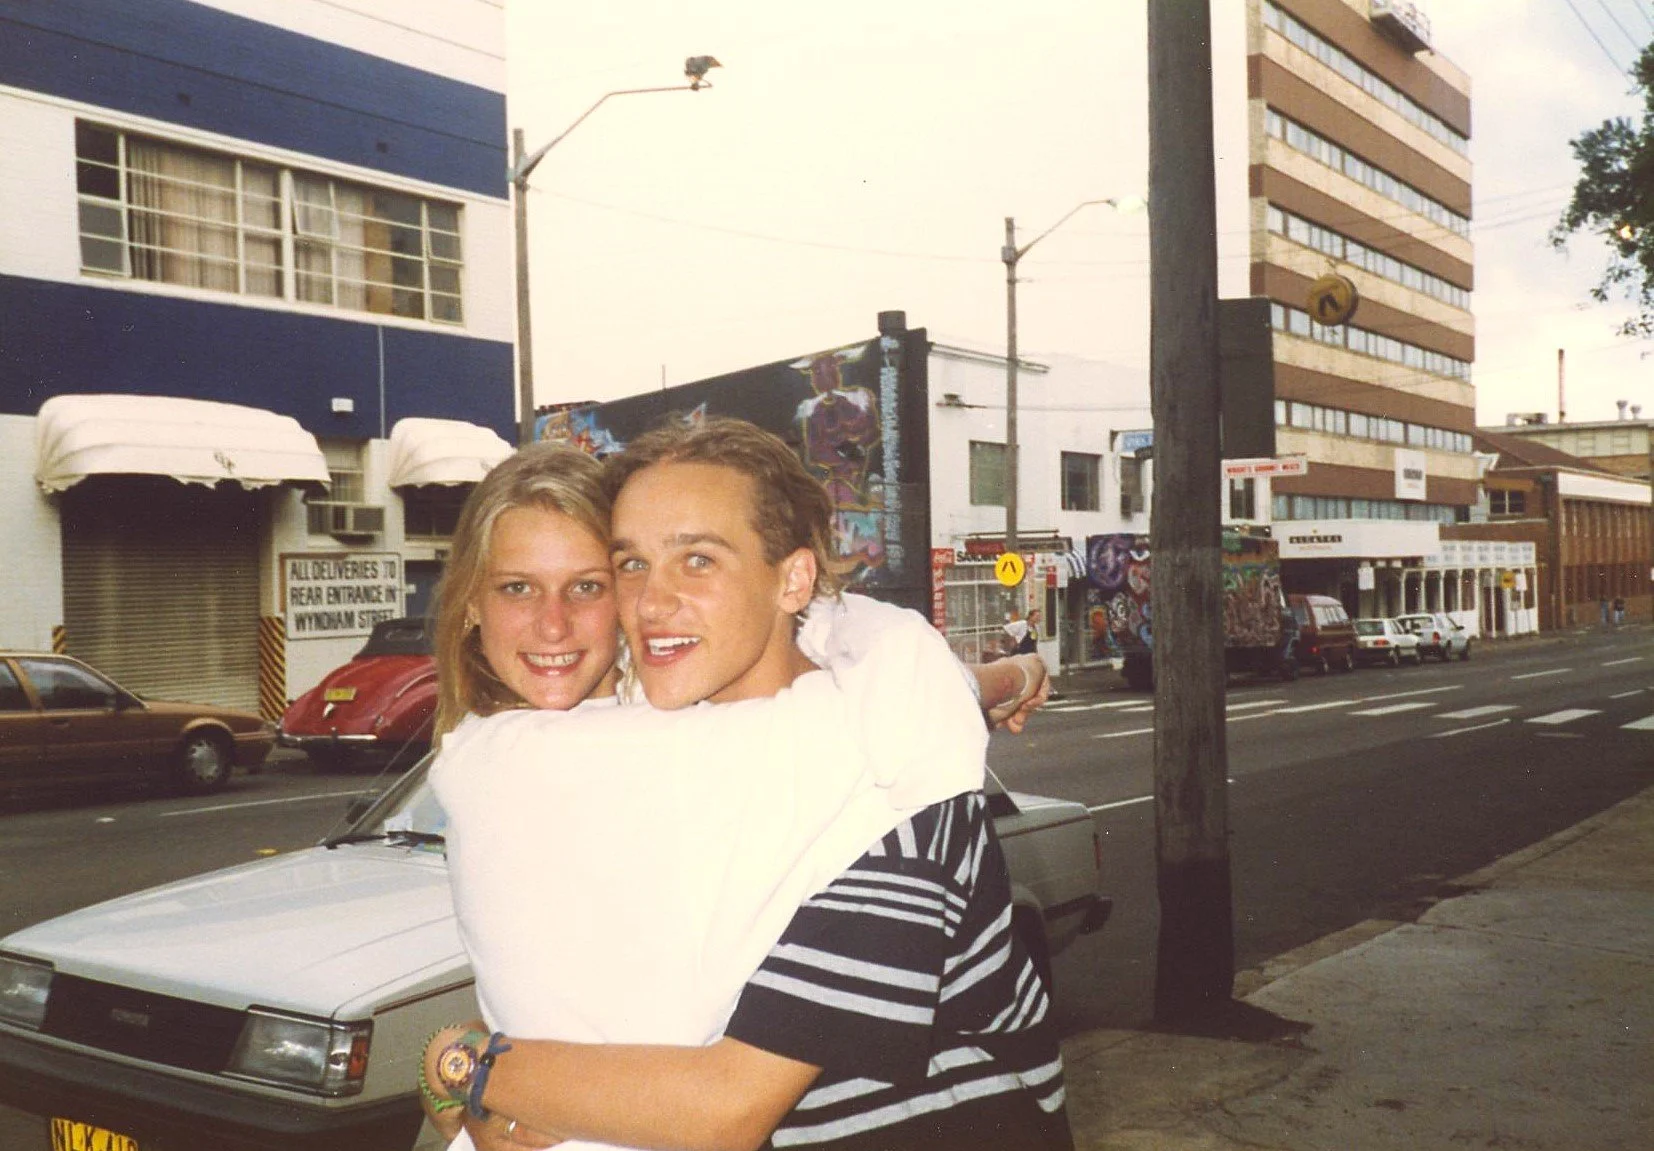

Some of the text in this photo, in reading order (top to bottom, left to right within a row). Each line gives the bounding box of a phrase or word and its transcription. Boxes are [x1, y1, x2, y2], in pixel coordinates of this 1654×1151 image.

[290, 560, 396, 580] ALL DELIVERIES TO
[290, 585, 396, 606] REAR ENTRANCE IN
[294, 611, 354, 631] WYNDHAM
